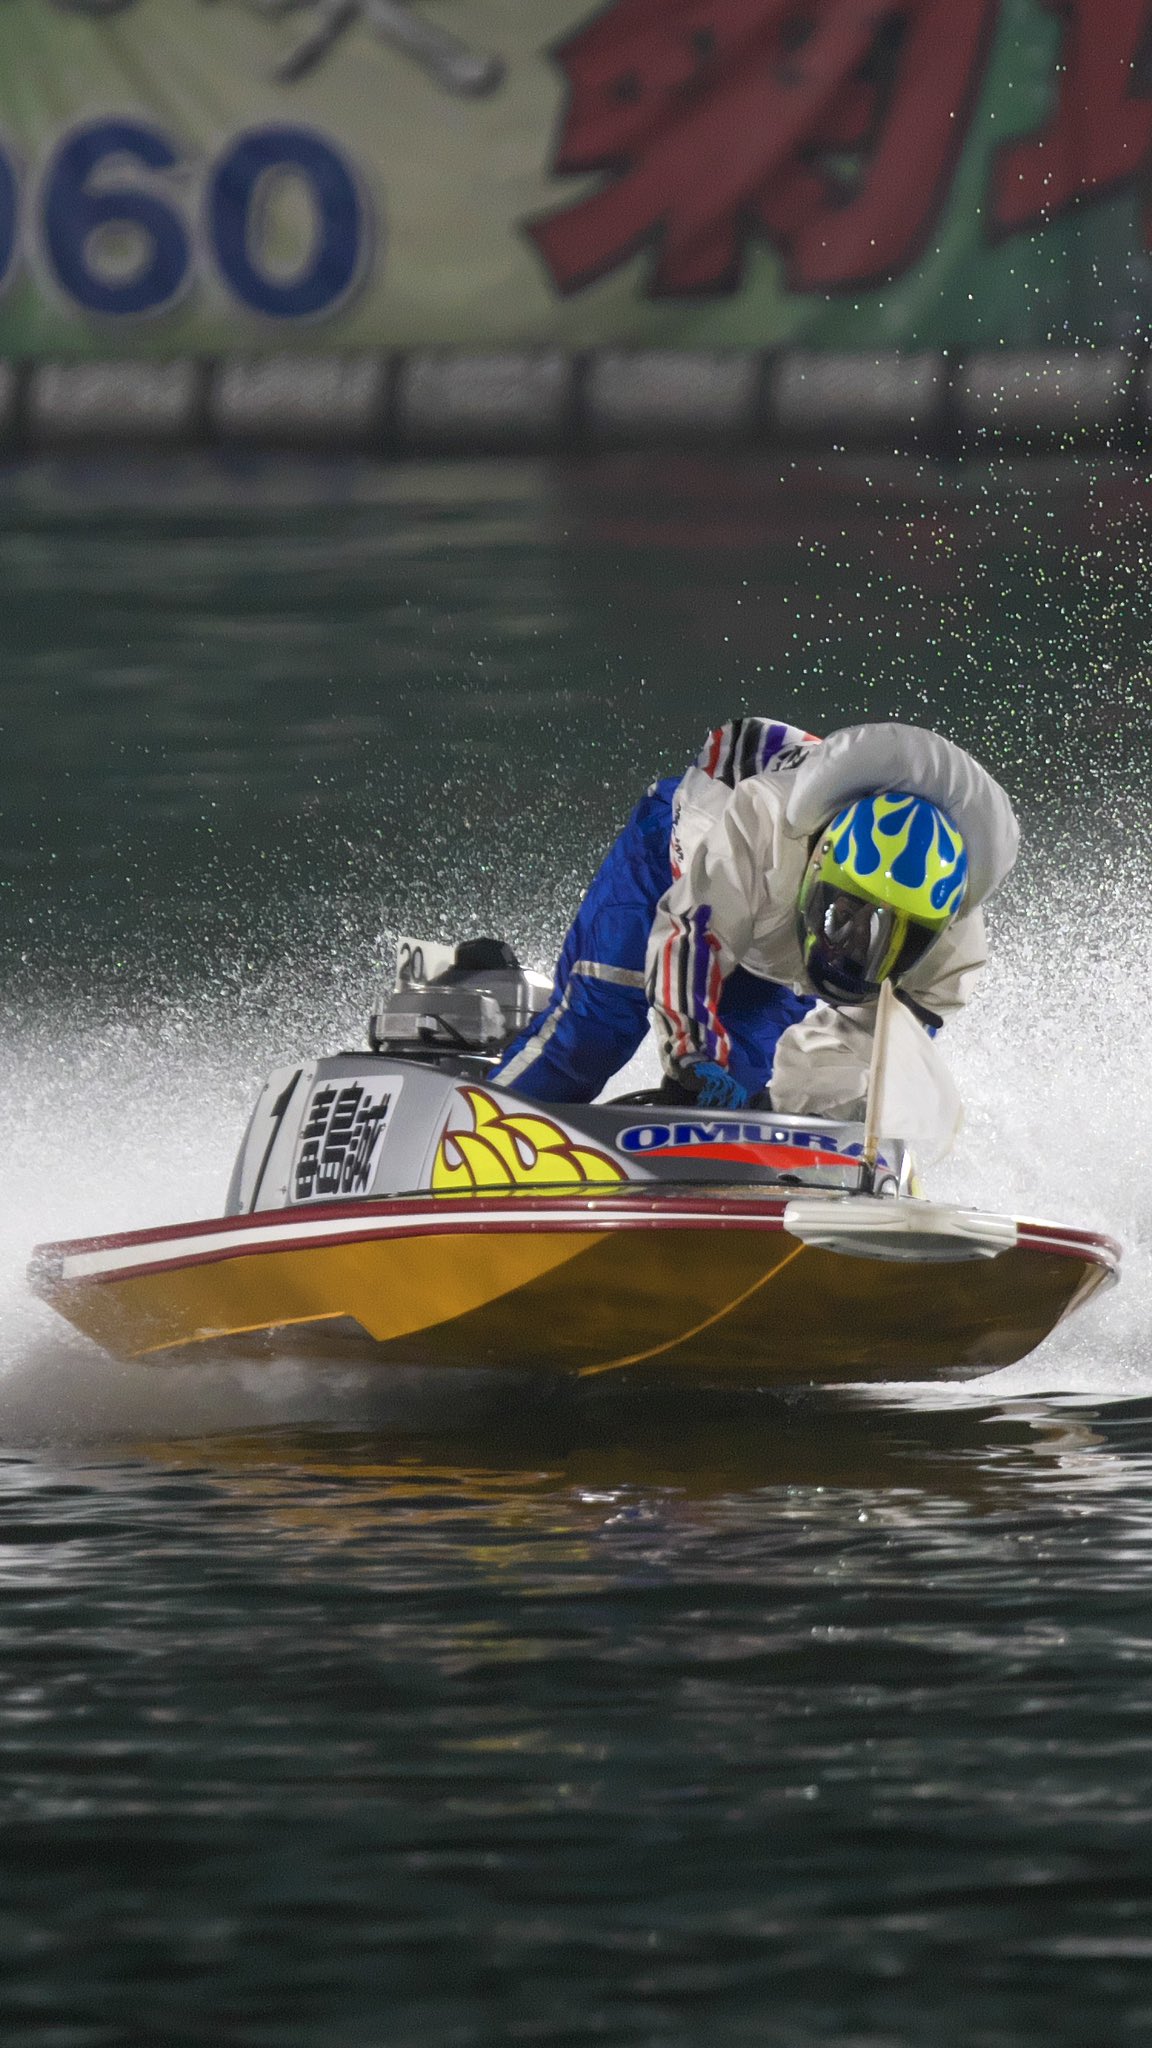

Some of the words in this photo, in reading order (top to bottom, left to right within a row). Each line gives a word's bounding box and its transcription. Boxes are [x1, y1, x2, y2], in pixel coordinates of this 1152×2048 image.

[0, 116, 364, 319] 60
[399, 942, 424, 983] 20
[251, 1069, 303, 1213] 1
